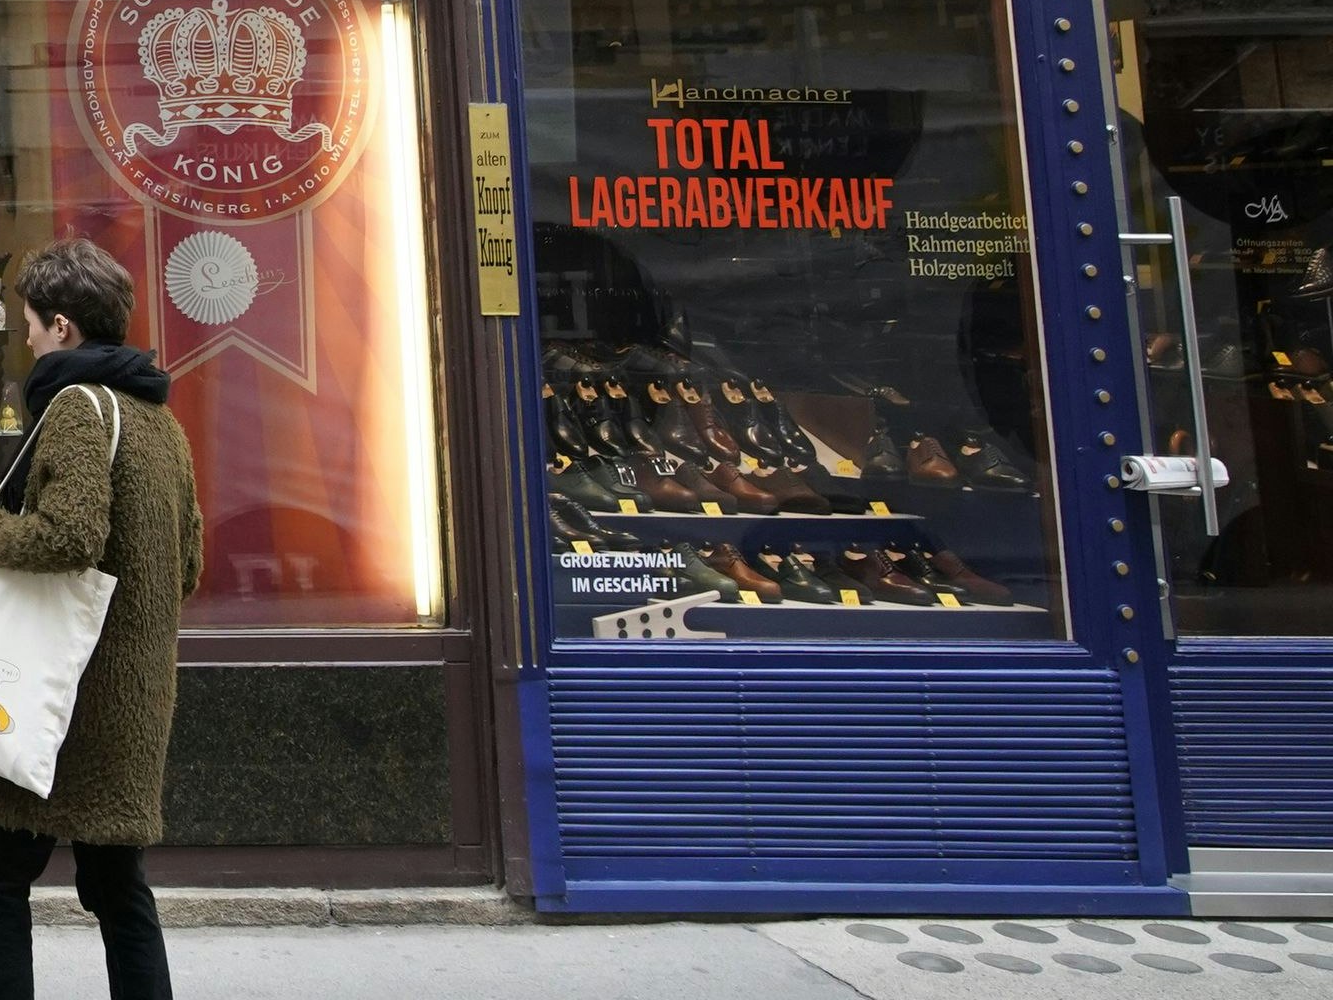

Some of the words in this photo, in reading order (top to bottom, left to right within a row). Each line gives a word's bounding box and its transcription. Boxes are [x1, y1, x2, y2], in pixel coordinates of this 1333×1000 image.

[480, 131, 500, 140] ZUM
[646, 118, 785, 171] TOTAL
[173, 154, 284, 184] KÖNIG
[476, 151, 507, 167] alten
[476, 176, 511, 224] Knopf
[568, 175, 894, 230] LAGERABVERKAUF
[905, 210, 1028, 233] Handgearbeitet
[478, 227, 514, 276] König
[906, 234, 1031, 257] Rahmengenäht
[909, 258, 1015, 280] Holzgenagelt
[613, 552, 687, 569] AUSWAHL
[572, 577, 591, 593] IM
[593, 574, 670, 593] GESCHÄFT
